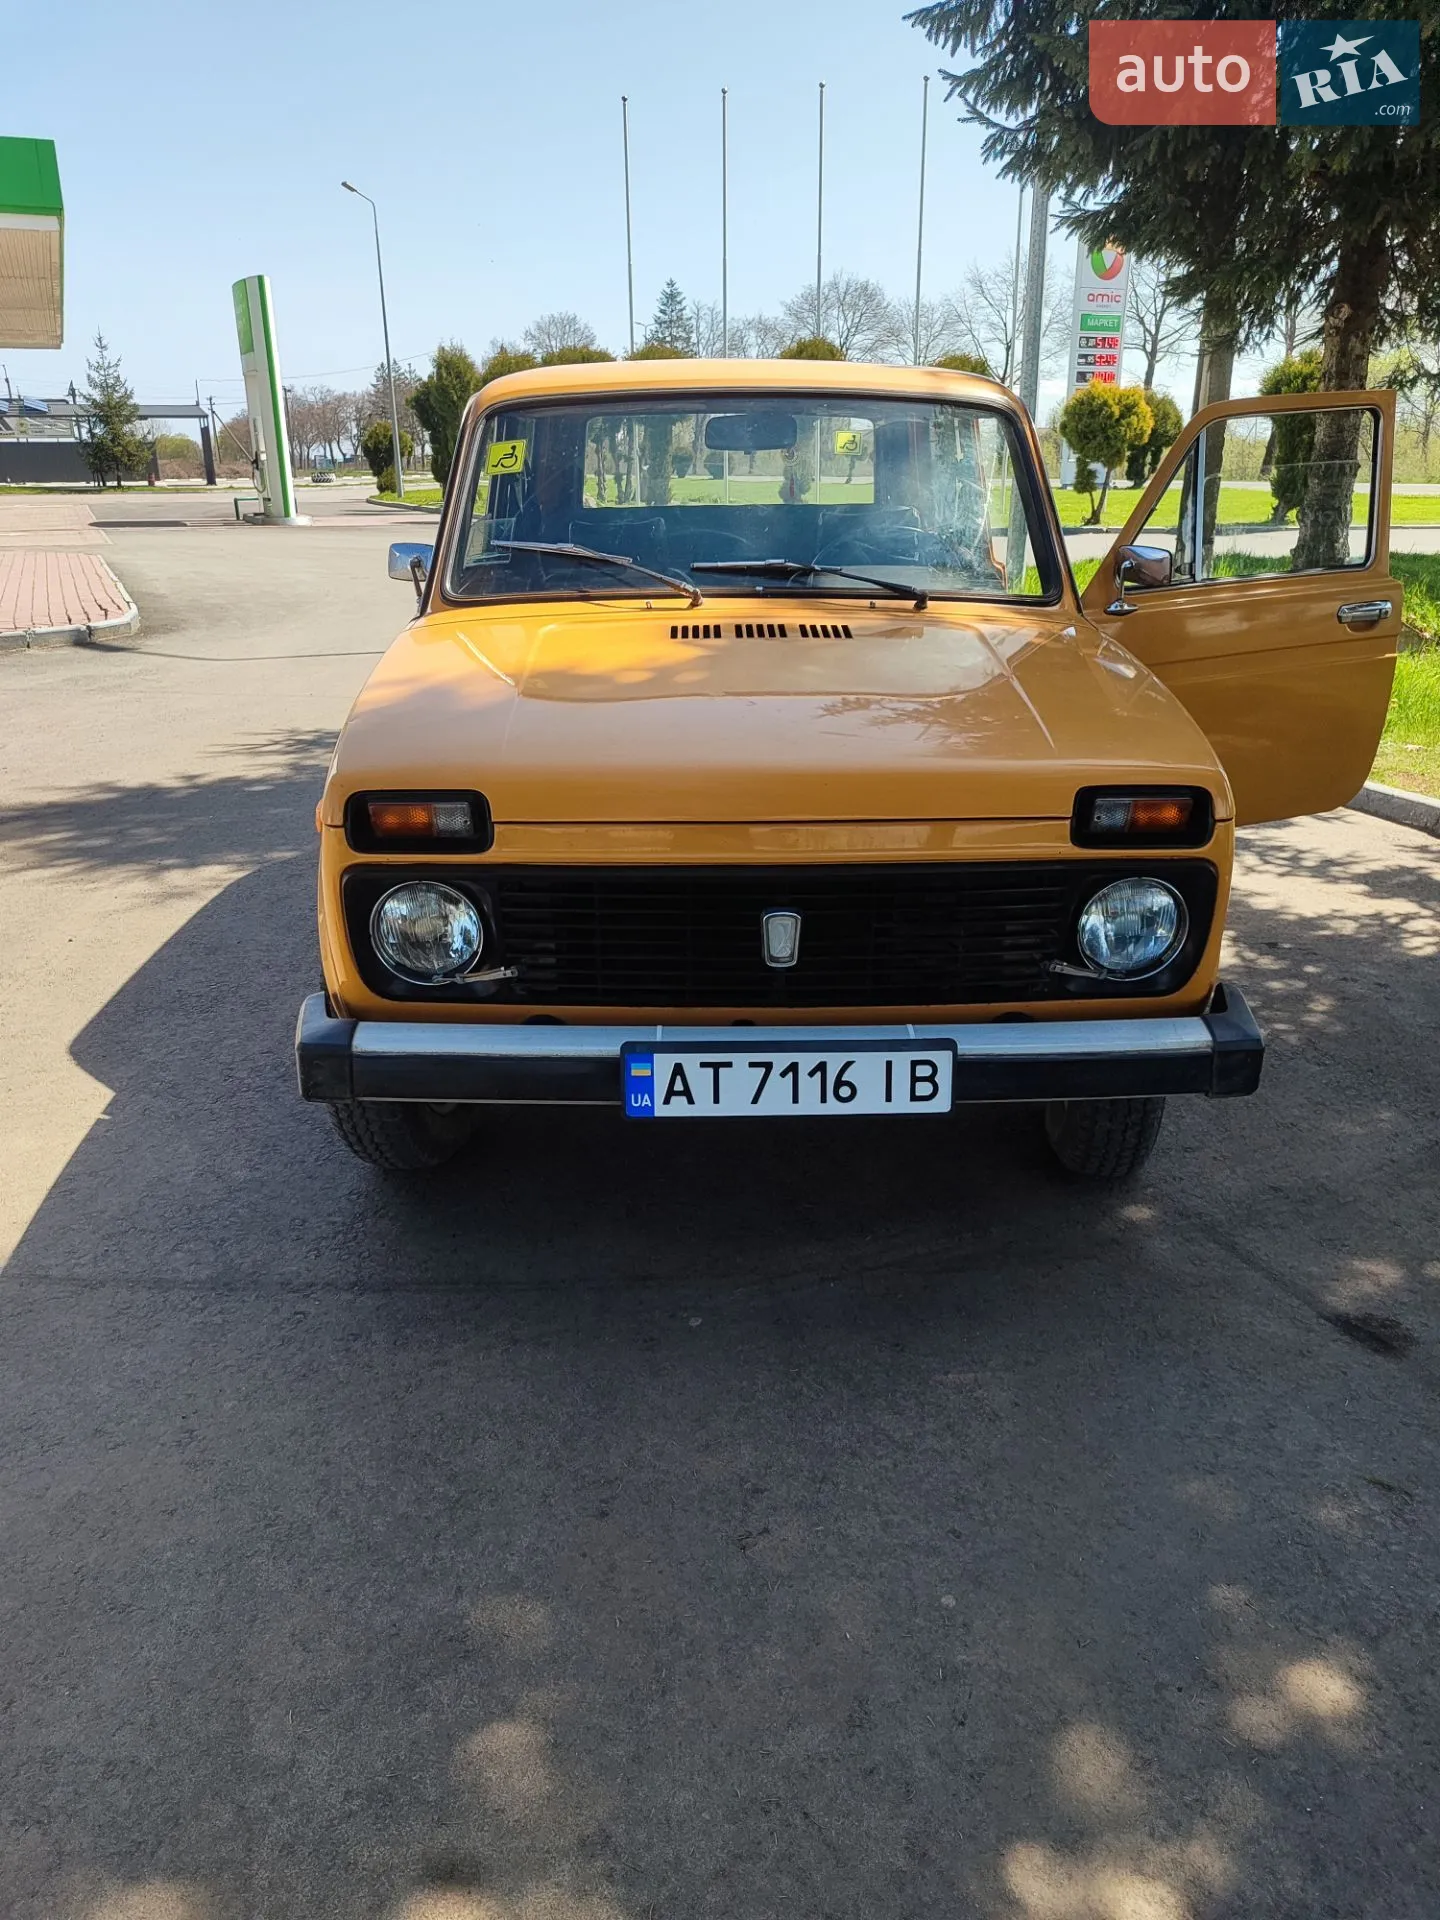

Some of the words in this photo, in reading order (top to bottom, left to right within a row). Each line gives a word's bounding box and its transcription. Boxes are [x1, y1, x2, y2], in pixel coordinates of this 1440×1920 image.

[1087, 291, 1121, 303] amic
[662, 1061, 733, 1105] AT
[748, 1060, 857, 1104] 7116
[885, 1059, 939, 1102] IB
[631, 1093, 651, 1107] UA
